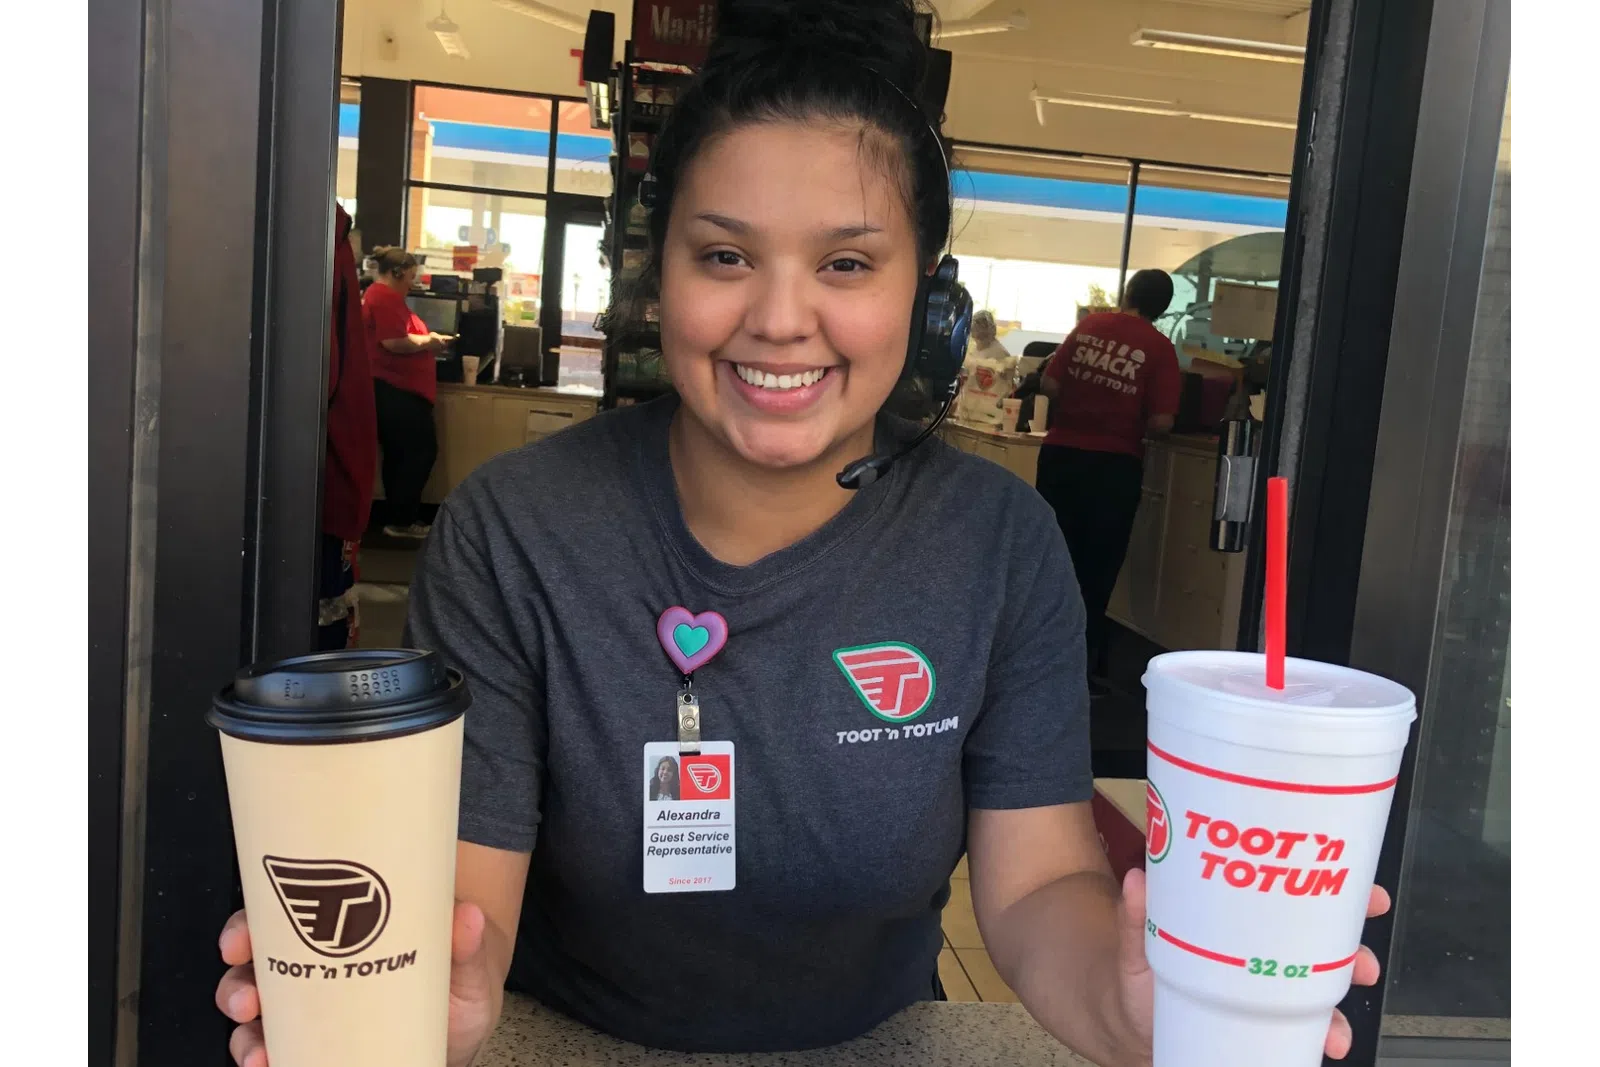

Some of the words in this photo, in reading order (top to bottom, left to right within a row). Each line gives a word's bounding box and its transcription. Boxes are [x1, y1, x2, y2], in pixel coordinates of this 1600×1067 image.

[1071, 345, 1142, 380] SNACK
[1106, 377, 1122, 391] TO
[836, 729, 882, 744] TOOT
[902, 716, 959, 738] TOTUM
[656, 808, 721, 822] Alexandra
[650, 832, 684, 843] Guest
[687, 831, 730, 842] Service
[1184, 809, 1308, 860] TOOT
[647, 844, 733, 858] Representative
[668, 877, 691, 886] Since
[693, 876, 712, 885] 2017
[1200, 851, 1350, 897] TOTUM
[267, 957, 316, 979] TOOT
[343, 949, 418, 979] TOTUM
[1247, 957, 1277, 977] 32
[1283, 965, 1310, 978] oz
